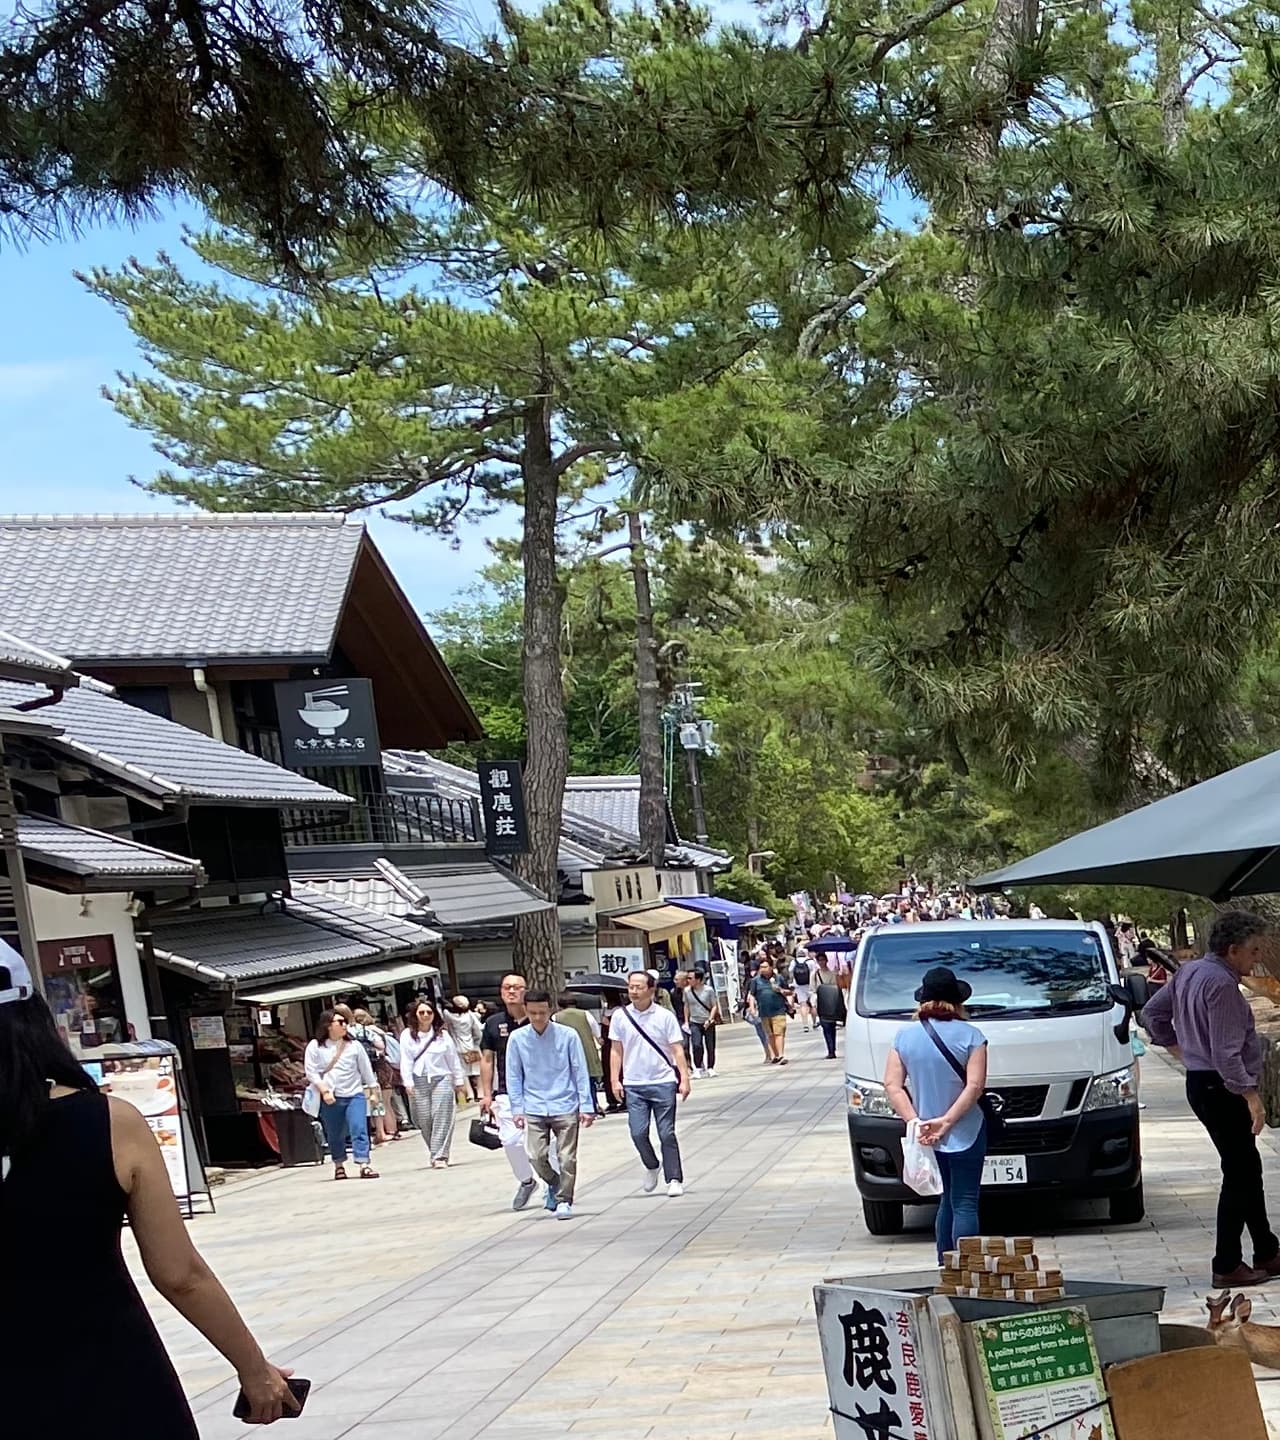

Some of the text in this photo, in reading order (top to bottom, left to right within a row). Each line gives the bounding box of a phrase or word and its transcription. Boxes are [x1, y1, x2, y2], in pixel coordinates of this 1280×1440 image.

[987, 1335, 1085, 1359] A polite request from the deer
[989, 1362, 1010, 1372] when
[1010, 1358, 1037, 1369] feeding
